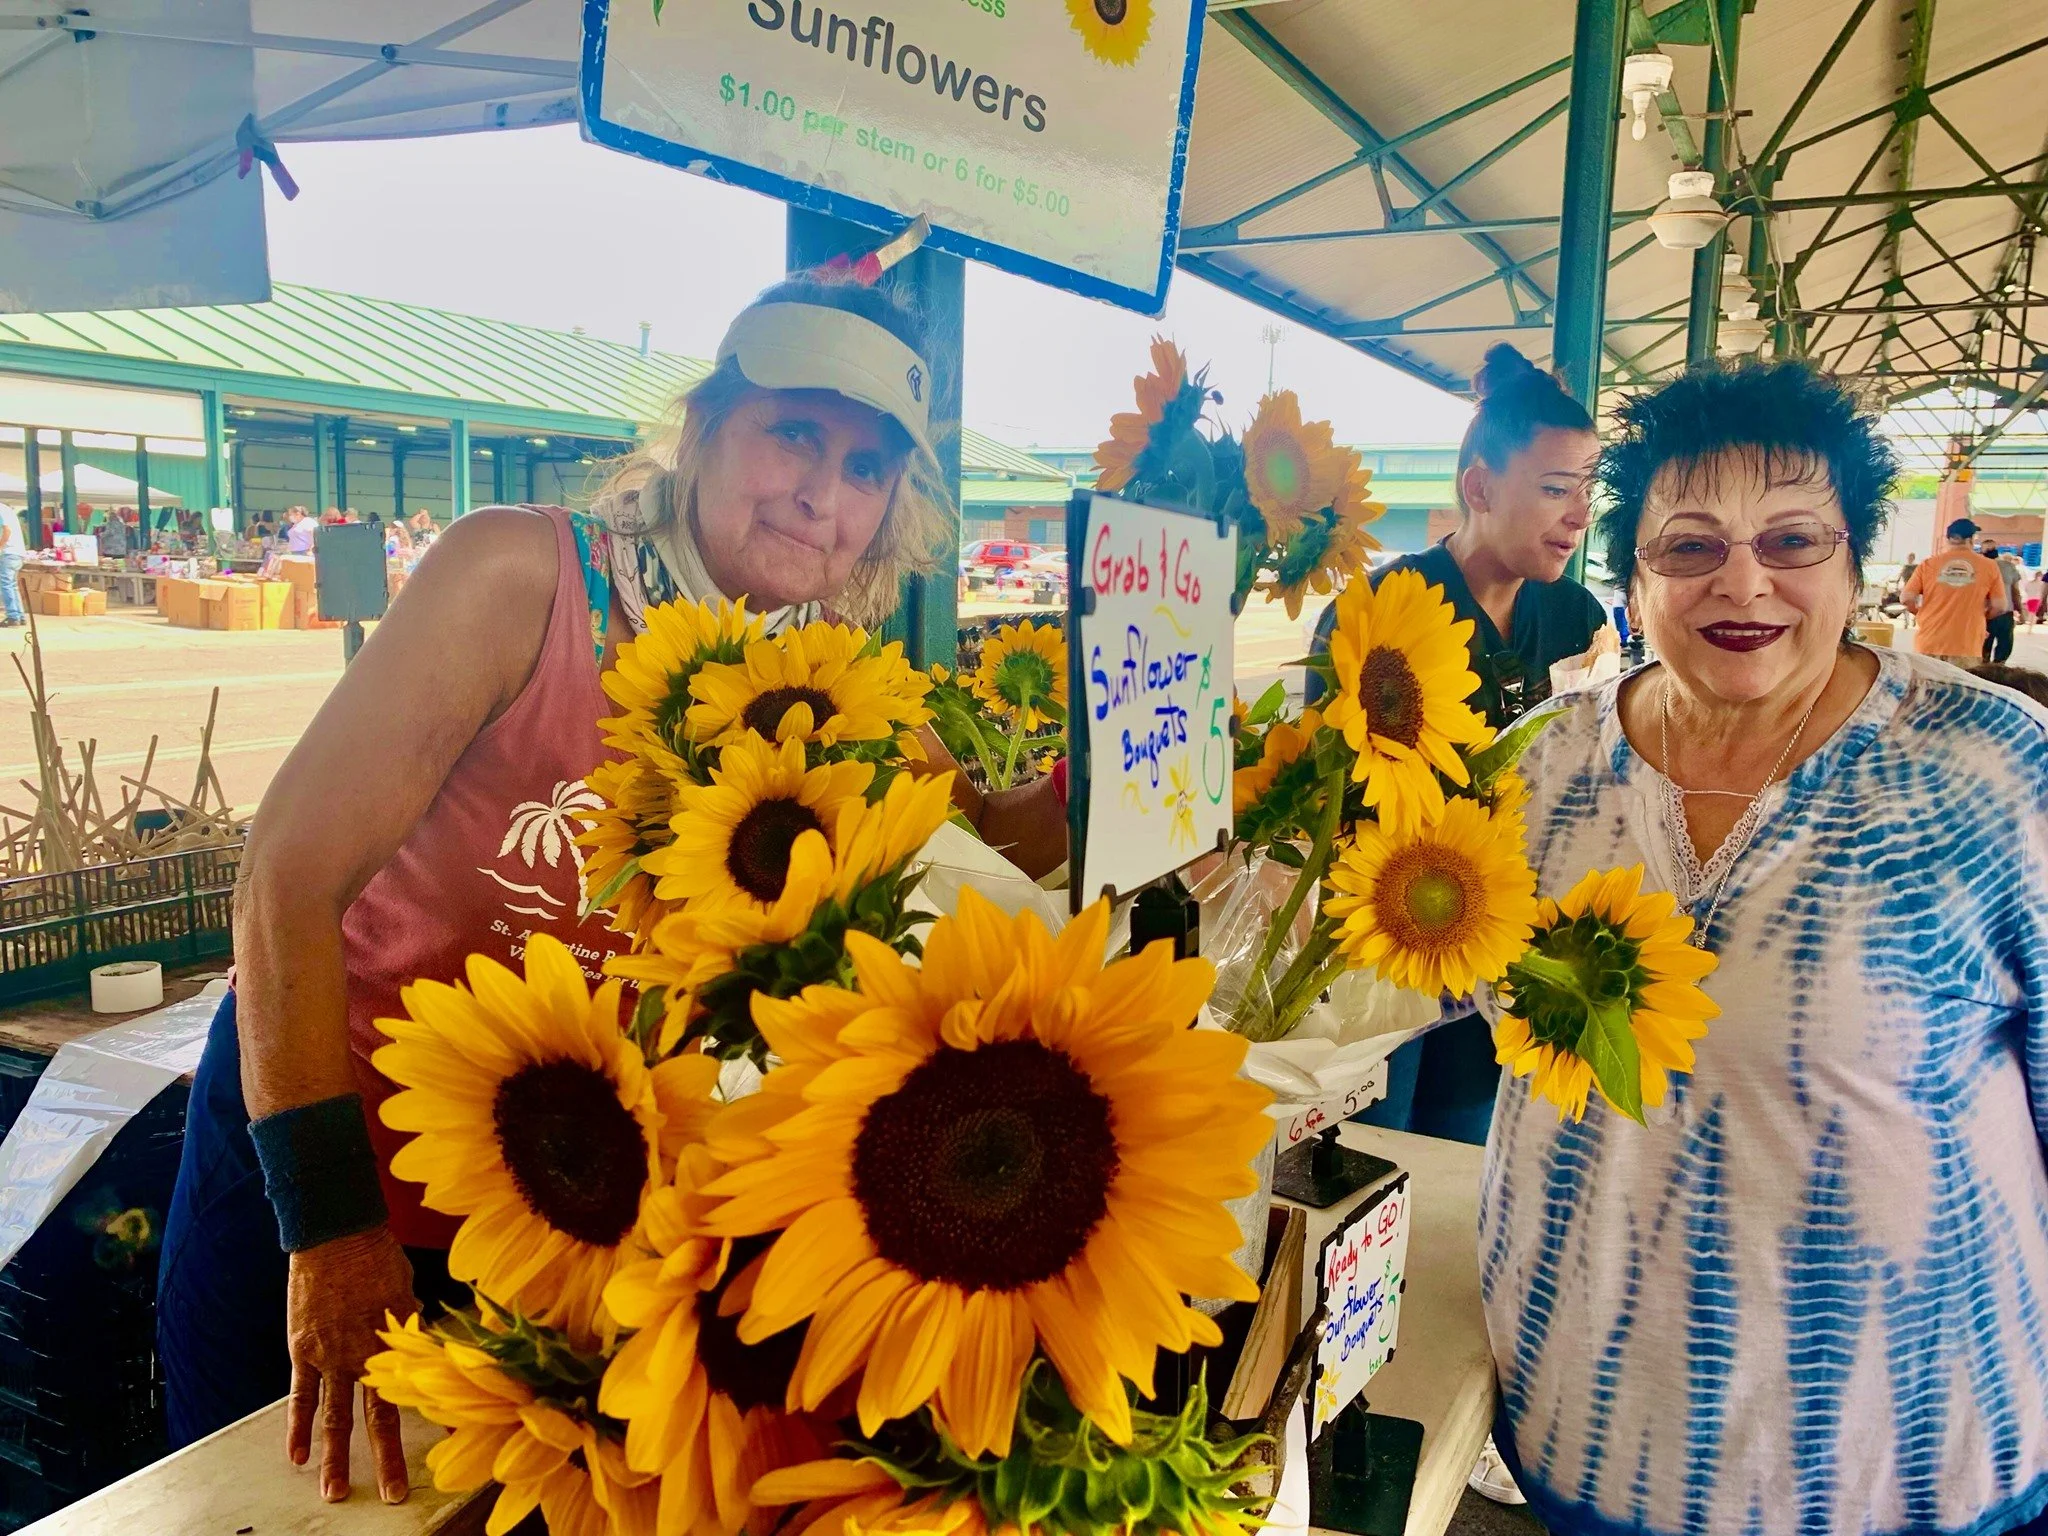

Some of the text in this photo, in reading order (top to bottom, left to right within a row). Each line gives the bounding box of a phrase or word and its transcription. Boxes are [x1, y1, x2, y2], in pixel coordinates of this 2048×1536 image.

[747, 0, 1047, 132] Sunflowers
[719, 73, 1070, 217] $1.00 per stem or 6 for $5.00
[1092, 523, 1149, 596] Grab
[1174, 537, 1201, 605] Go
[1091, 624, 1198, 722] Sunflower
[1121, 694, 1188, 789] Bouquets
[490, 919, 512, 937] St.
[516, 929, 600, 961] Atine
[1289, 1117, 1303, 1142] 6
[1342, 1080, 1375, 1116] 5.00
[1328, 1239, 1358, 1292] Ready
[1361, 1220, 1372, 1252] to
[1326, 1276, 1382, 1344] Sunflower
